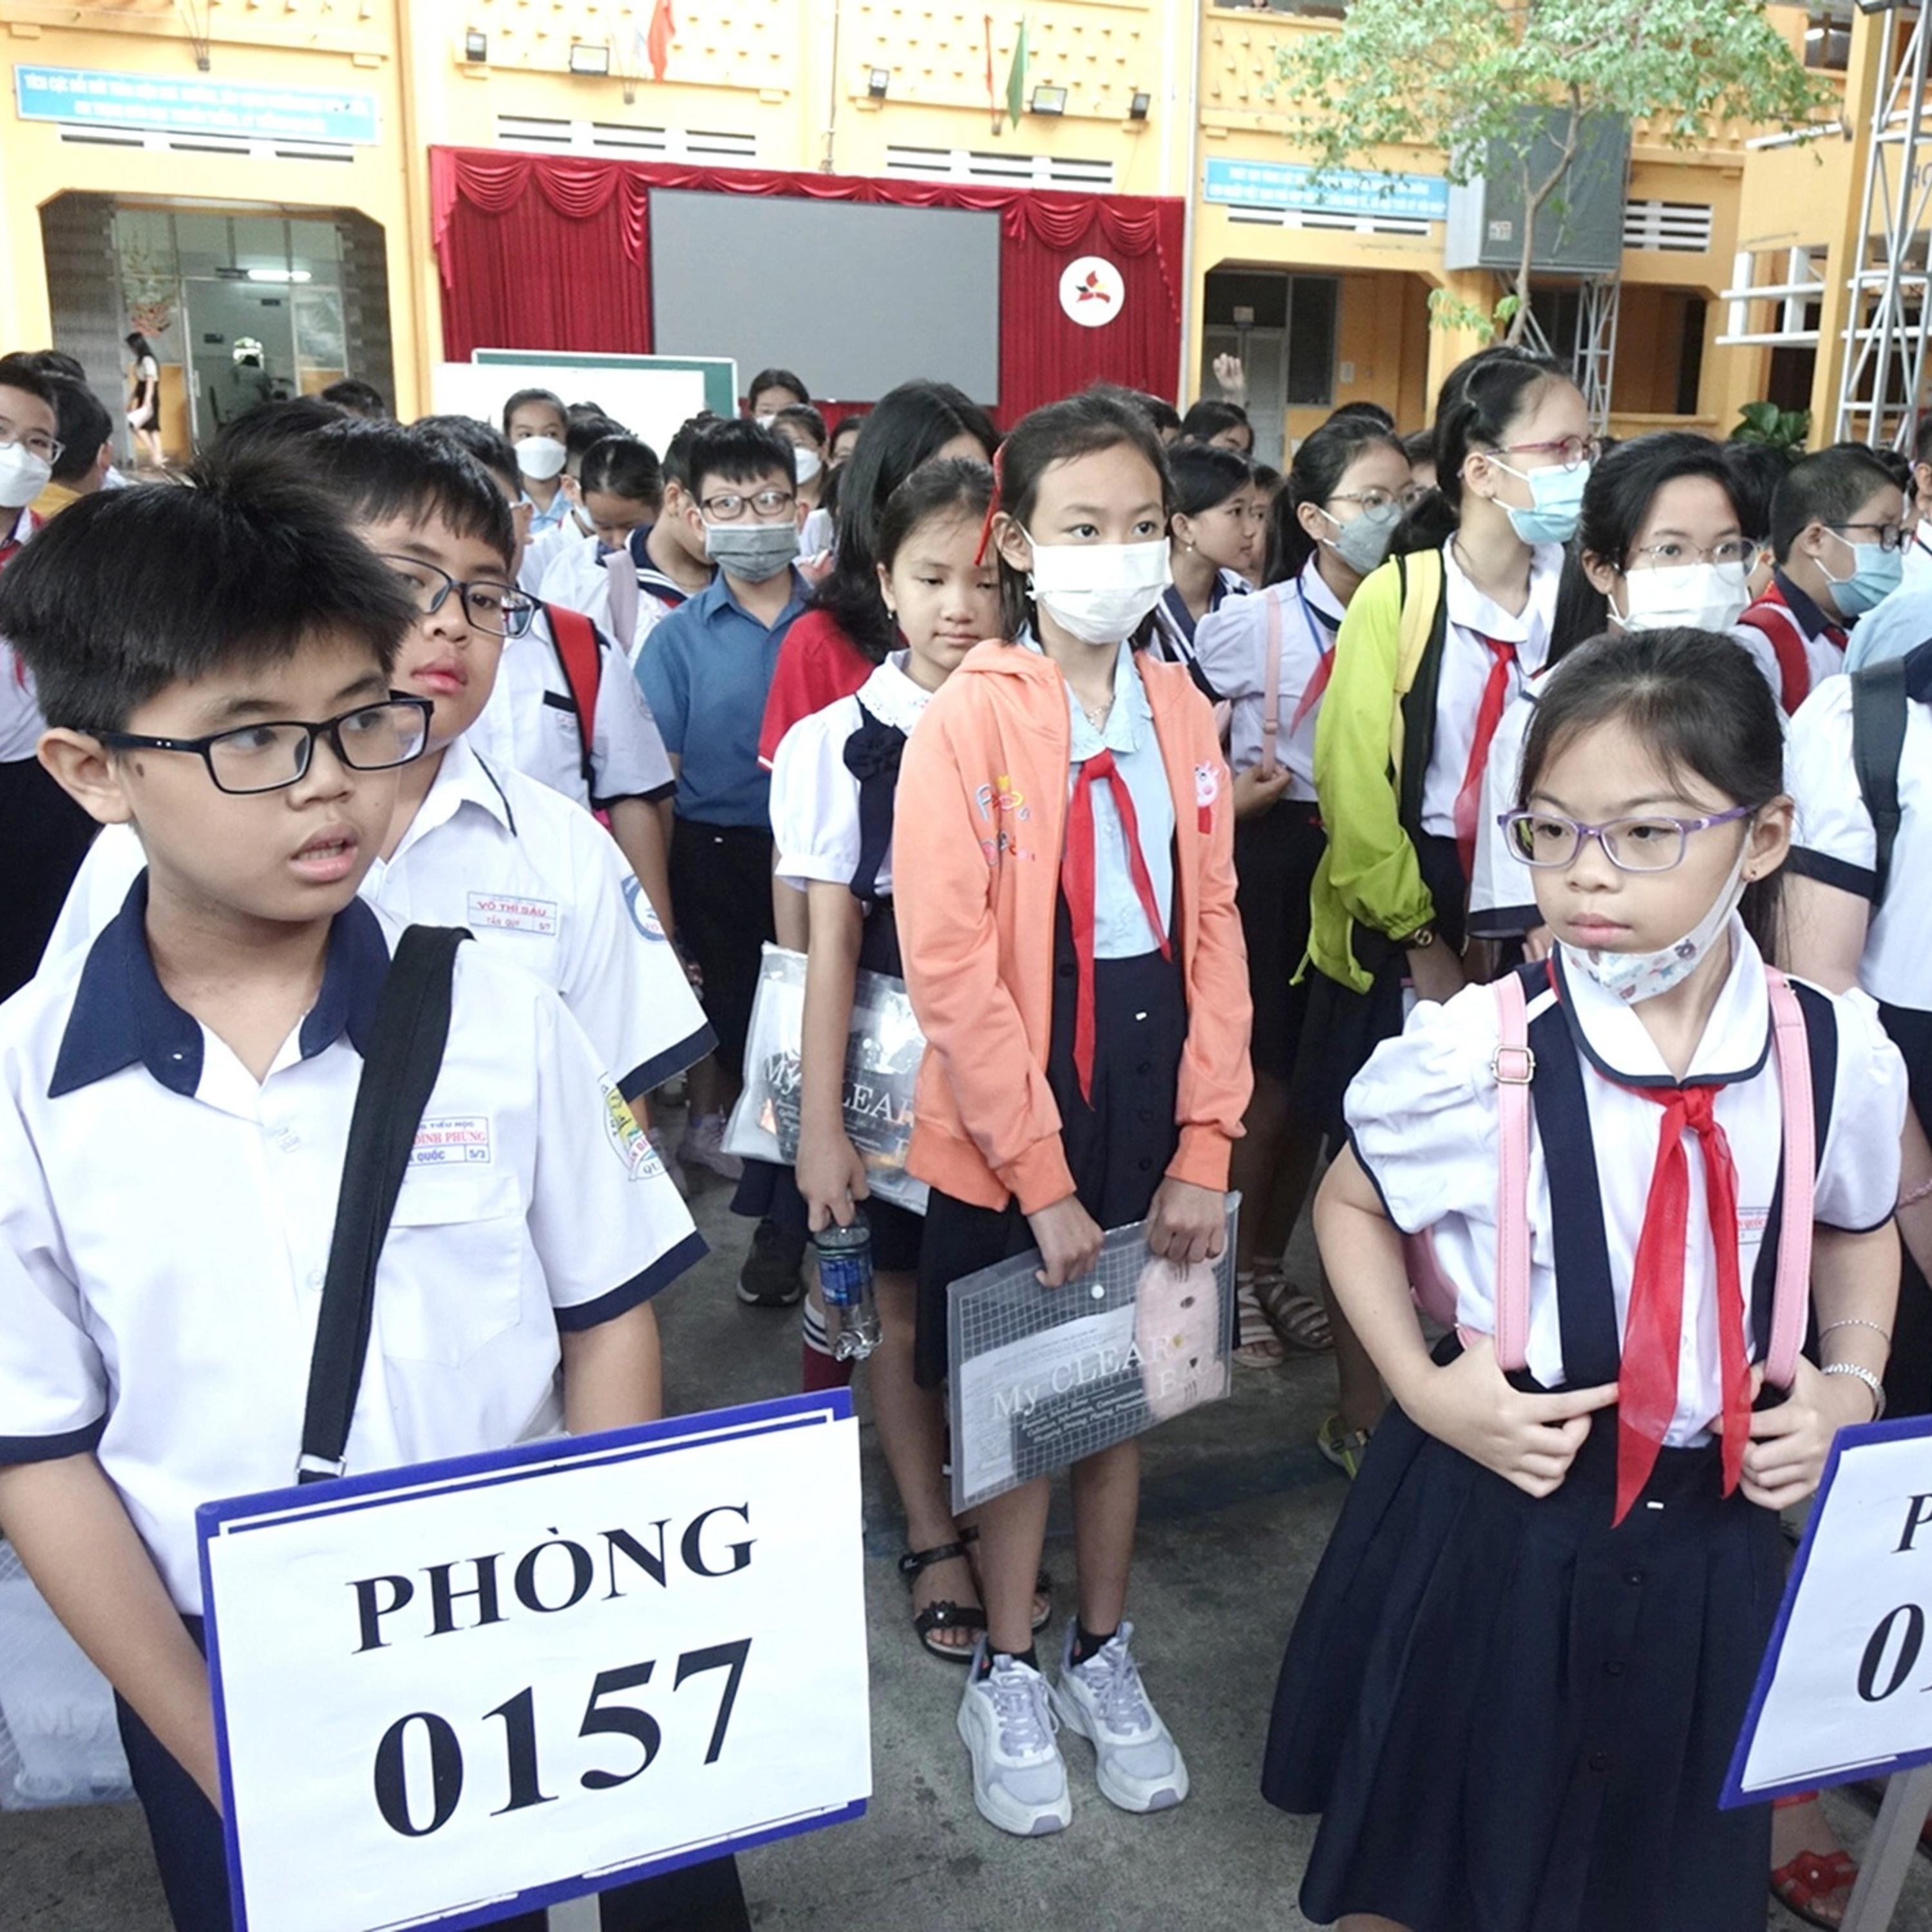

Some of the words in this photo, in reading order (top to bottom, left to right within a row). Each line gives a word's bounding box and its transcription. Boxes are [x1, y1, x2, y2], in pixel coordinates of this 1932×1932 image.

[992, 1383, 1039, 1418] My
[1051, 1335, 1173, 1394] CLEAR
[345, 1502, 758, 1654] PHÒNG
[374, 1638, 752, 1837] 0157
